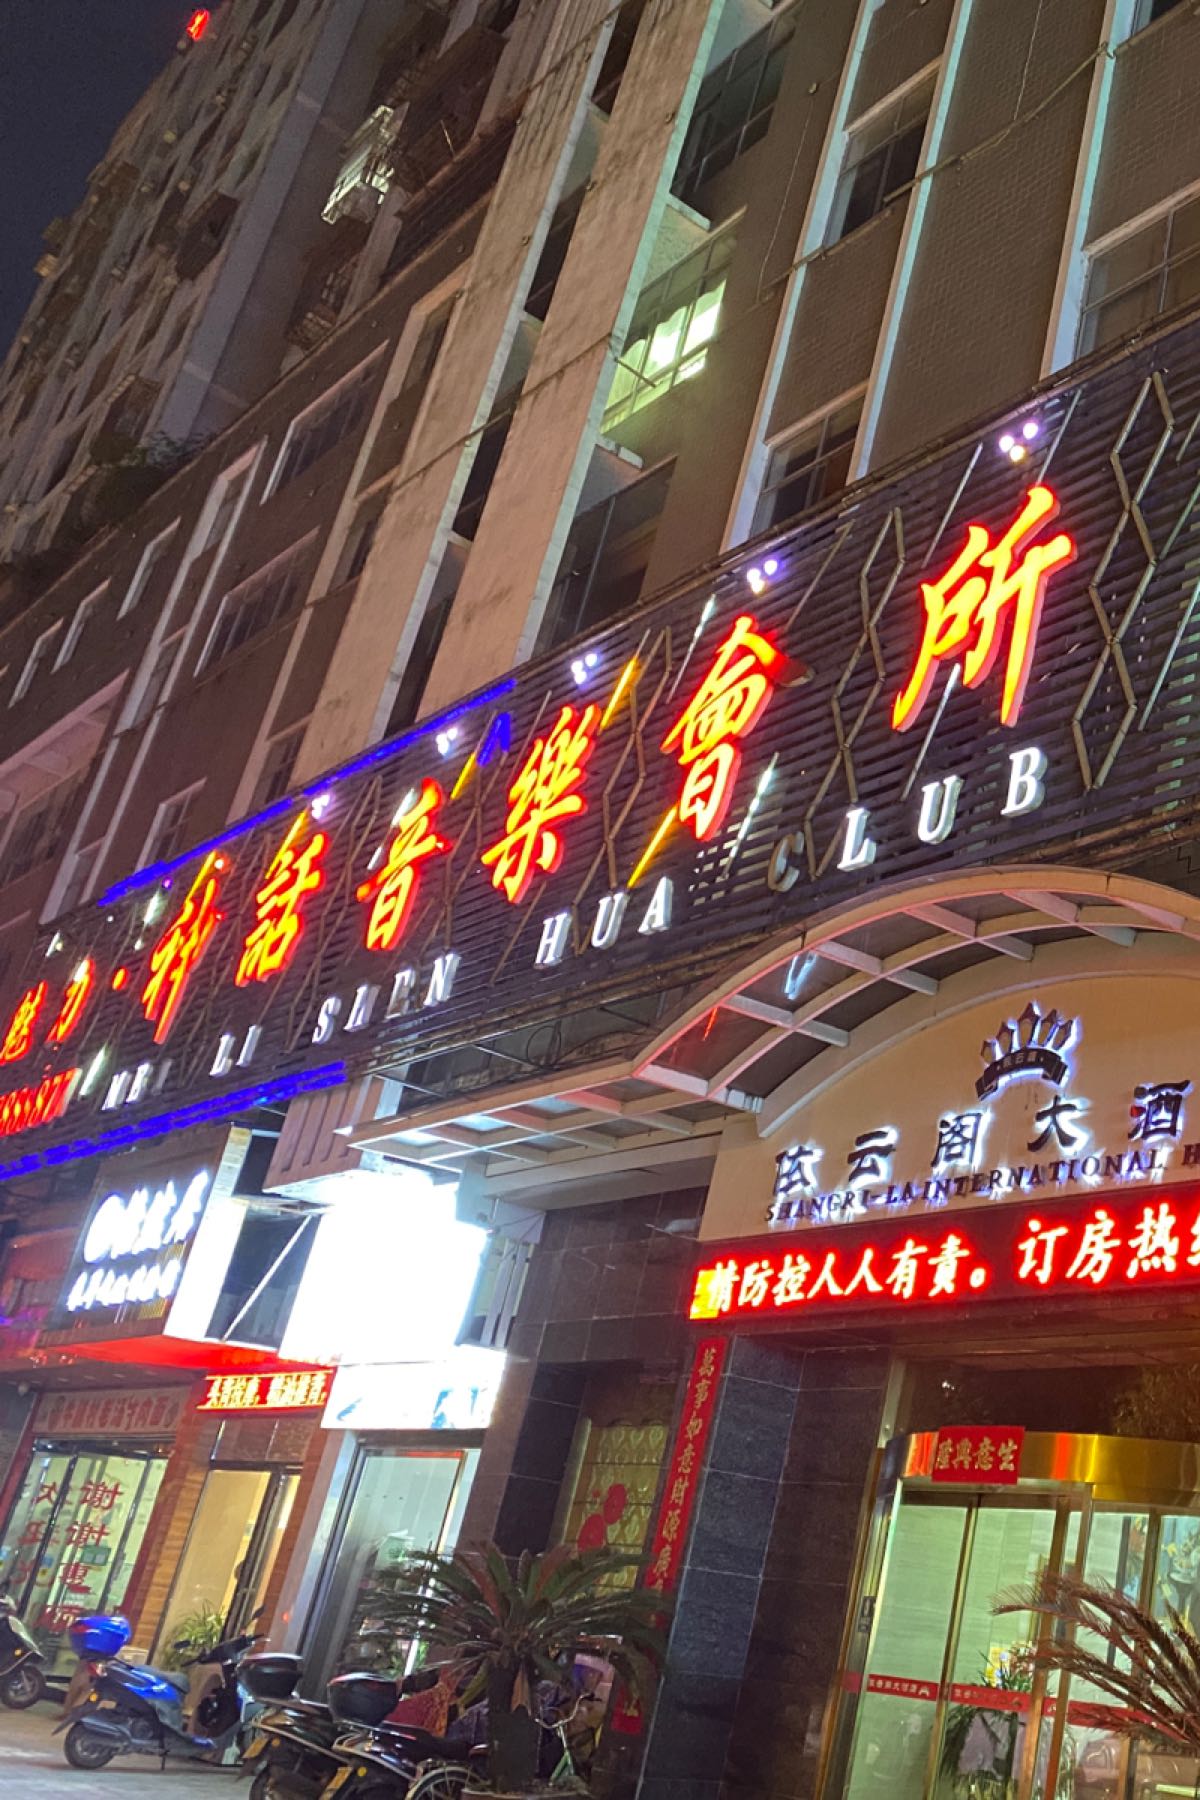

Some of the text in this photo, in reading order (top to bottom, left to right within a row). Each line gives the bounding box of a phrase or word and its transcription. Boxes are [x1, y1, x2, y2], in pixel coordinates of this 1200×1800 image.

[312, 952, 462, 1044] SHEN
[536, 877, 674, 971] HUA
[768, 747, 1048, 893] CLUB
